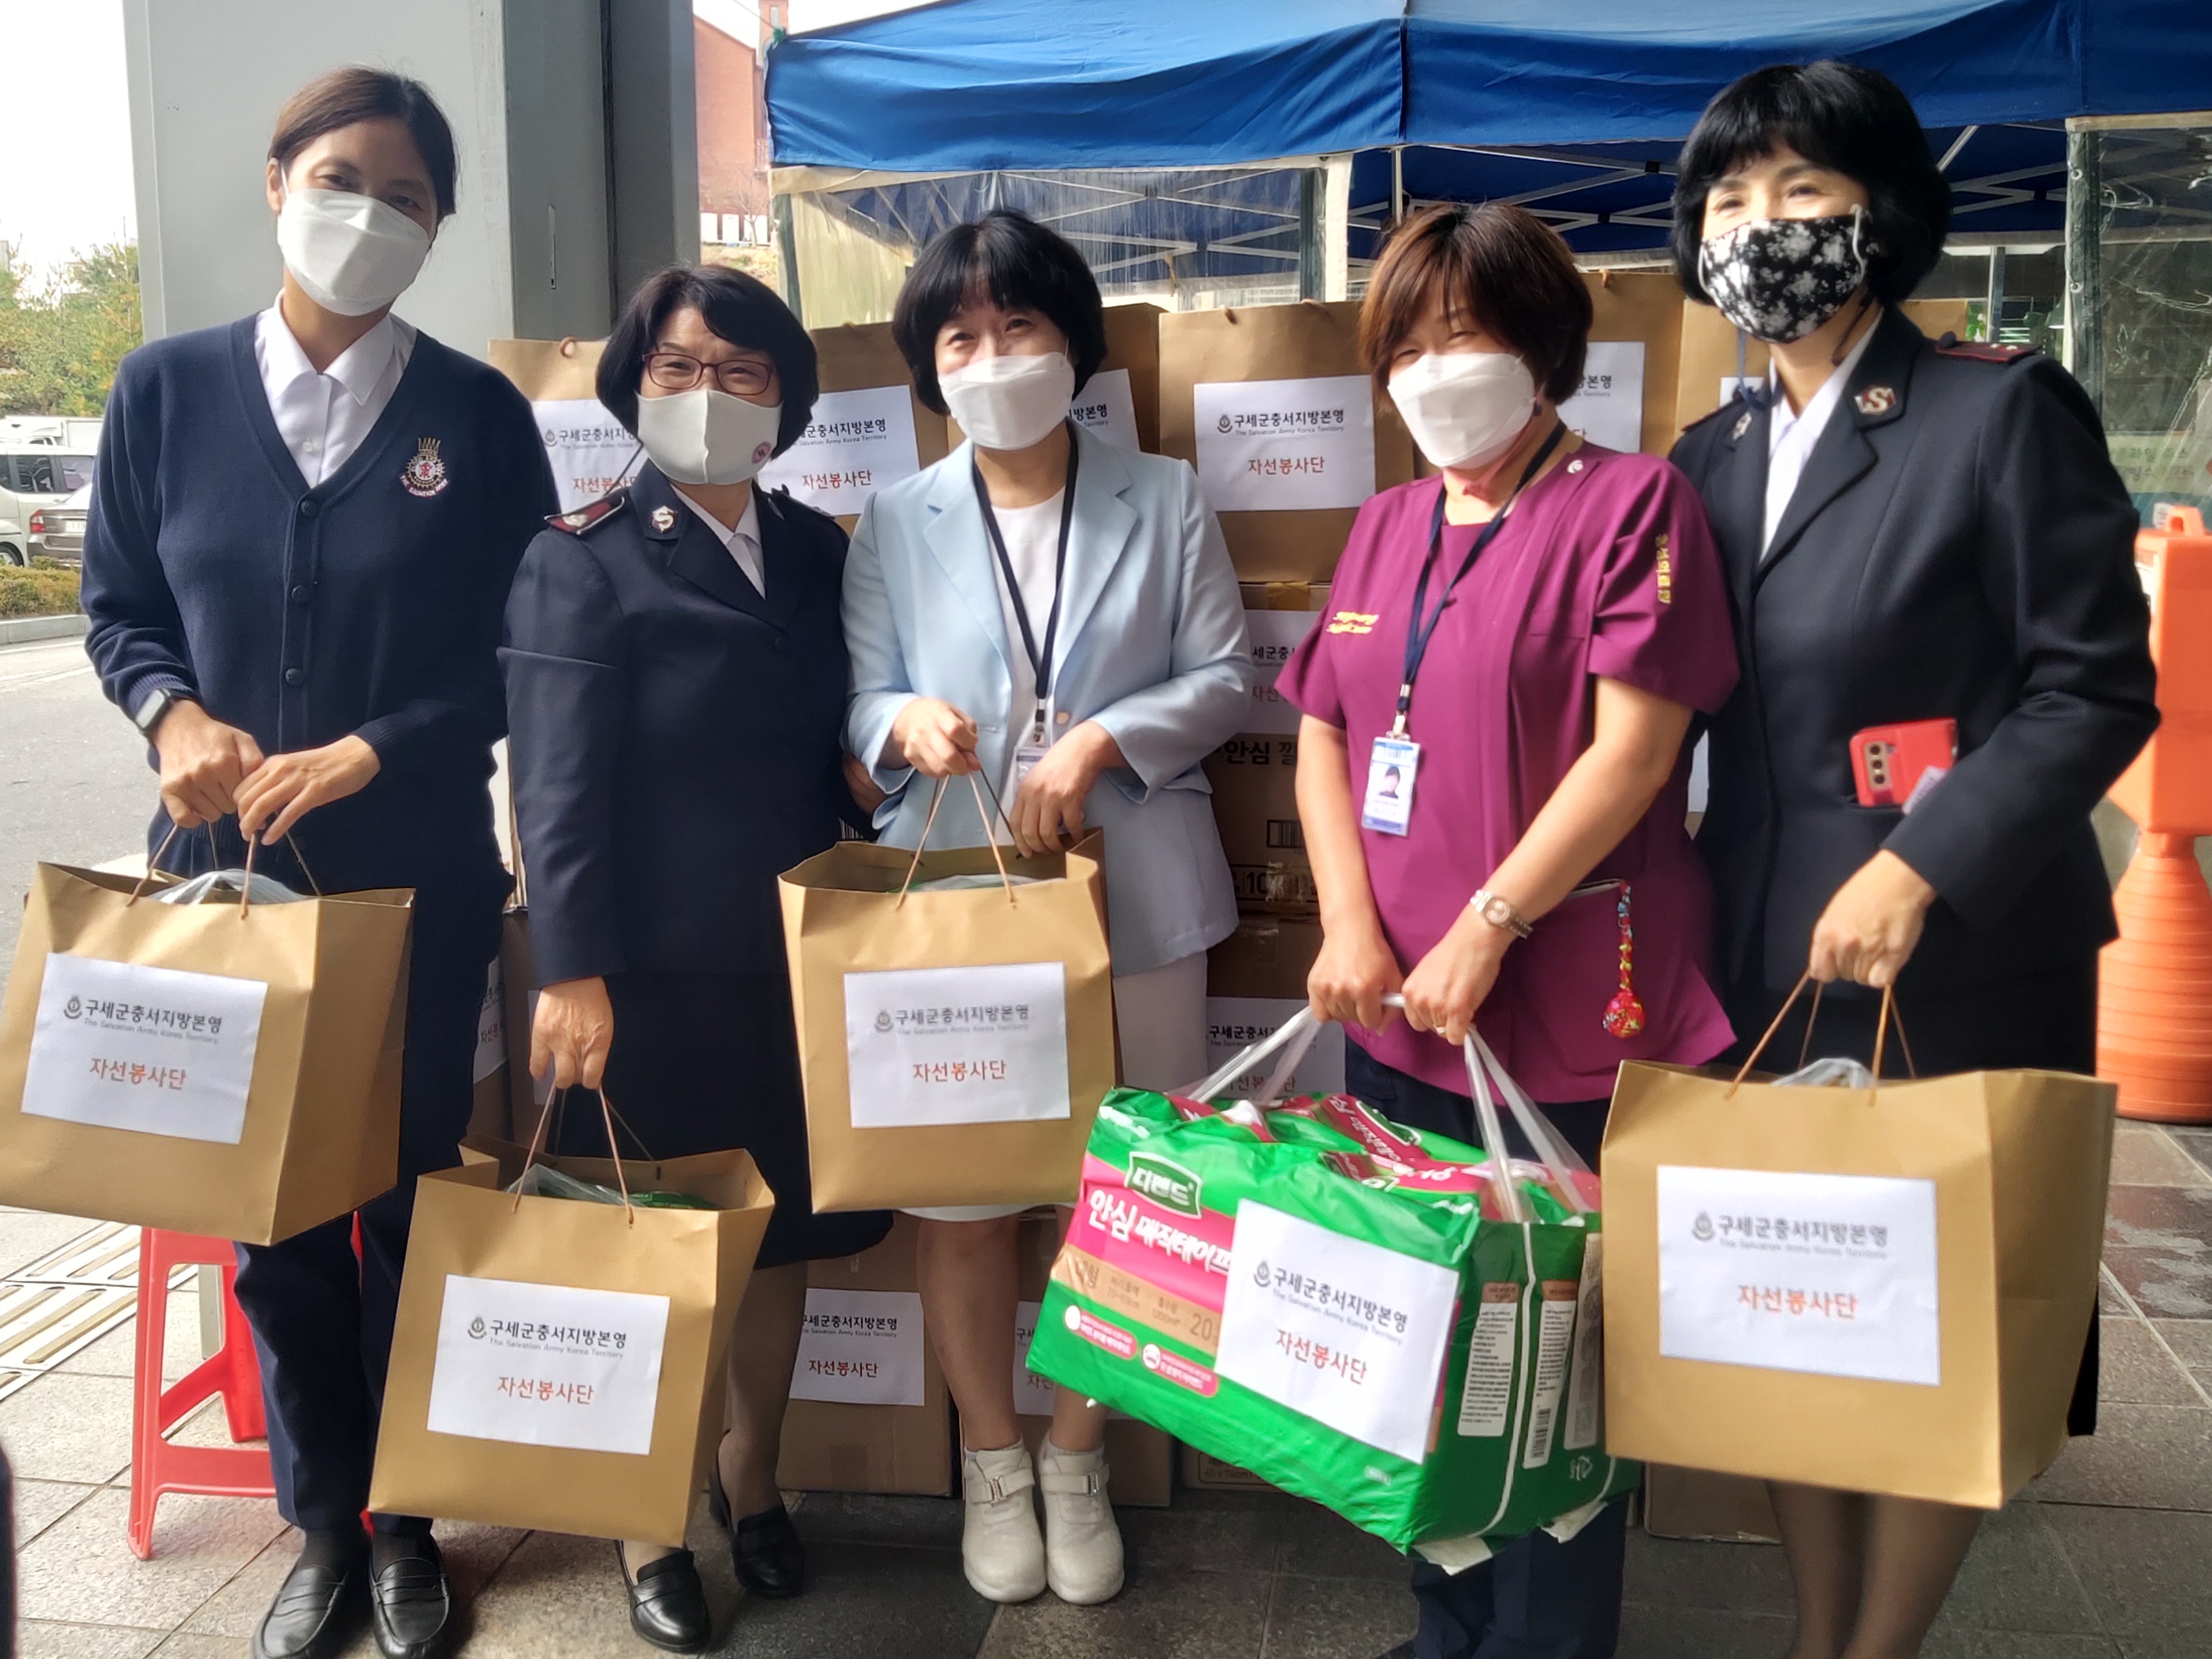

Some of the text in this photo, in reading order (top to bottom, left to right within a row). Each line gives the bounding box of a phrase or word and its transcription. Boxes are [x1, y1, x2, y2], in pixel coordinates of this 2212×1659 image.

[801, 419, 886, 438] 군충서지방본영
[1234, 409, 1343, 428] 구세군충서지방본영
[802, 469, 872, 489] 자선봉사단
[1248, 456, 1325, 475] 자선봉사단
[1252, 646, 1294, 660] 세군충
[1224, 740, 1269, 765] 안심
[86, 999, 222, 1034] 구세군충서지방본영
[896, 1004, 1029, 1025] 구세군충서지방본영
[89, 1058, 187, 1091] 자선봉사단
[912, 1060, 1007, 1083] 자선봉사단
[1089, 1189, 1139, 1243] 안심
[1718, 1215, 1888, 1248] 구세군충서지방본영
[1274, 1267, 1407, 1333] 구세군충서지방본영
[1737, 1284, 1858, 1319] 자선봉사단
[490, 1320, 627, 1349] 구세군충서지방본영
[1190, 1313, 1219, 1346] 20
[490, 1338, 623, 1359] The Salvation Army Korea Territory
[1276, 1328, 1367, 1385] 자선봉사단
[808, 1360, 878, 1378] 자선봉사단
[497, 1376, 595, 1405] 자선봉사단
